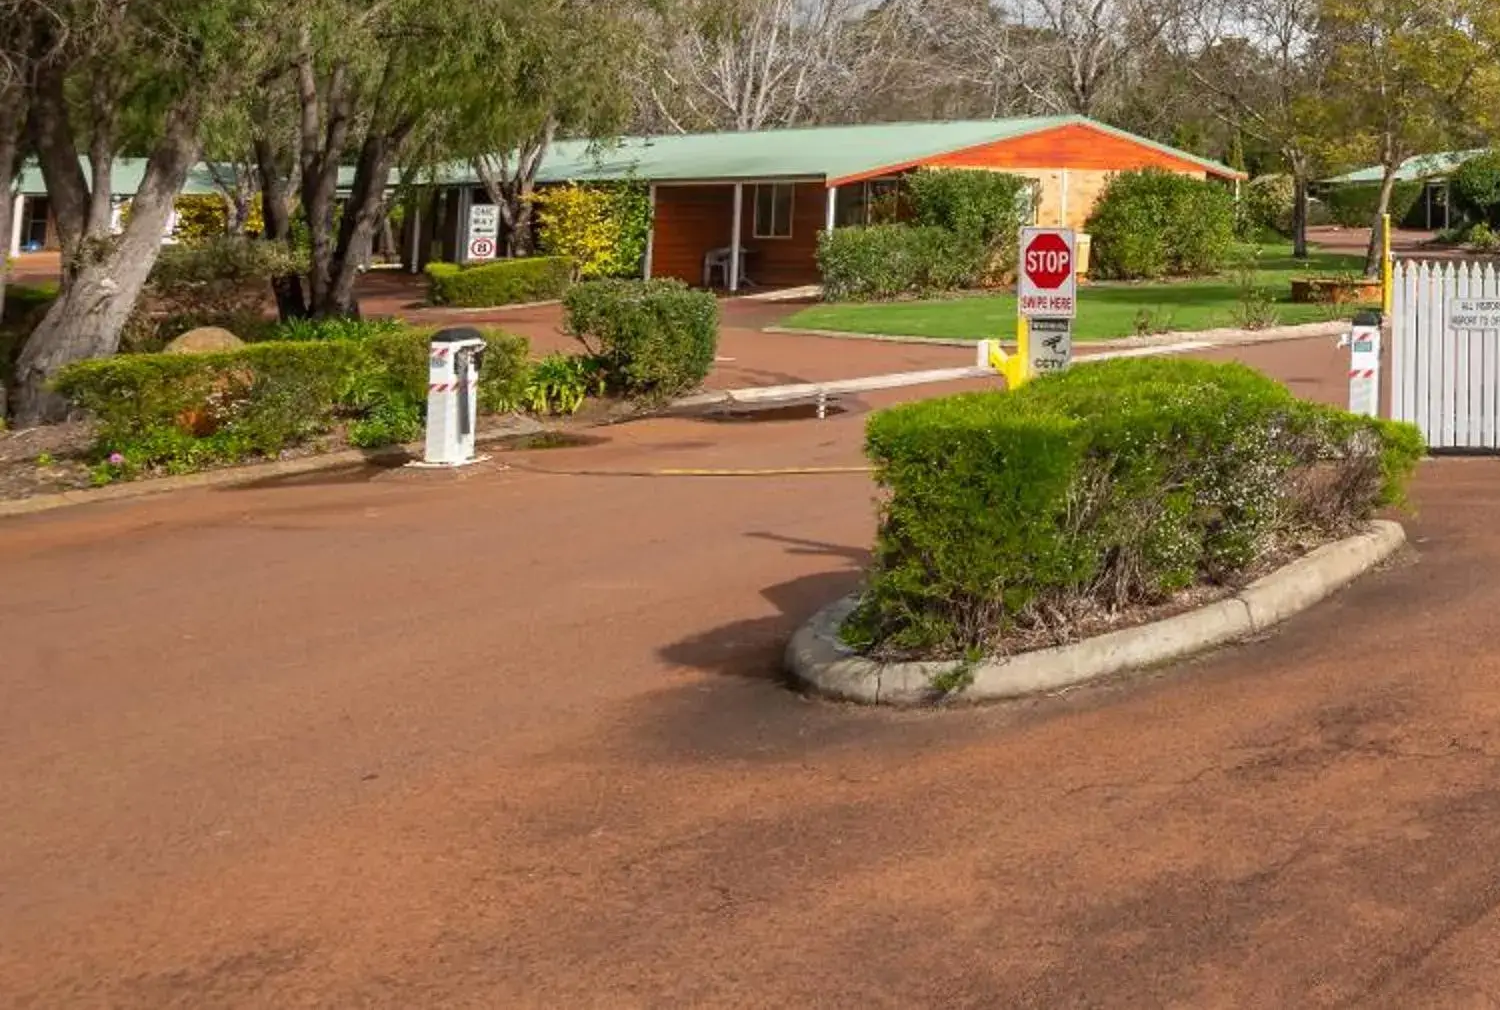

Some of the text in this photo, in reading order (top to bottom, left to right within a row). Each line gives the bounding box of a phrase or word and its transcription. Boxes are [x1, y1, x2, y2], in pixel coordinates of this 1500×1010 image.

[1027, 251, 1069, 273] STOP
[1050, 296, 1072, 310] HERE
[1035, 357, 1063, 369] CCTV
